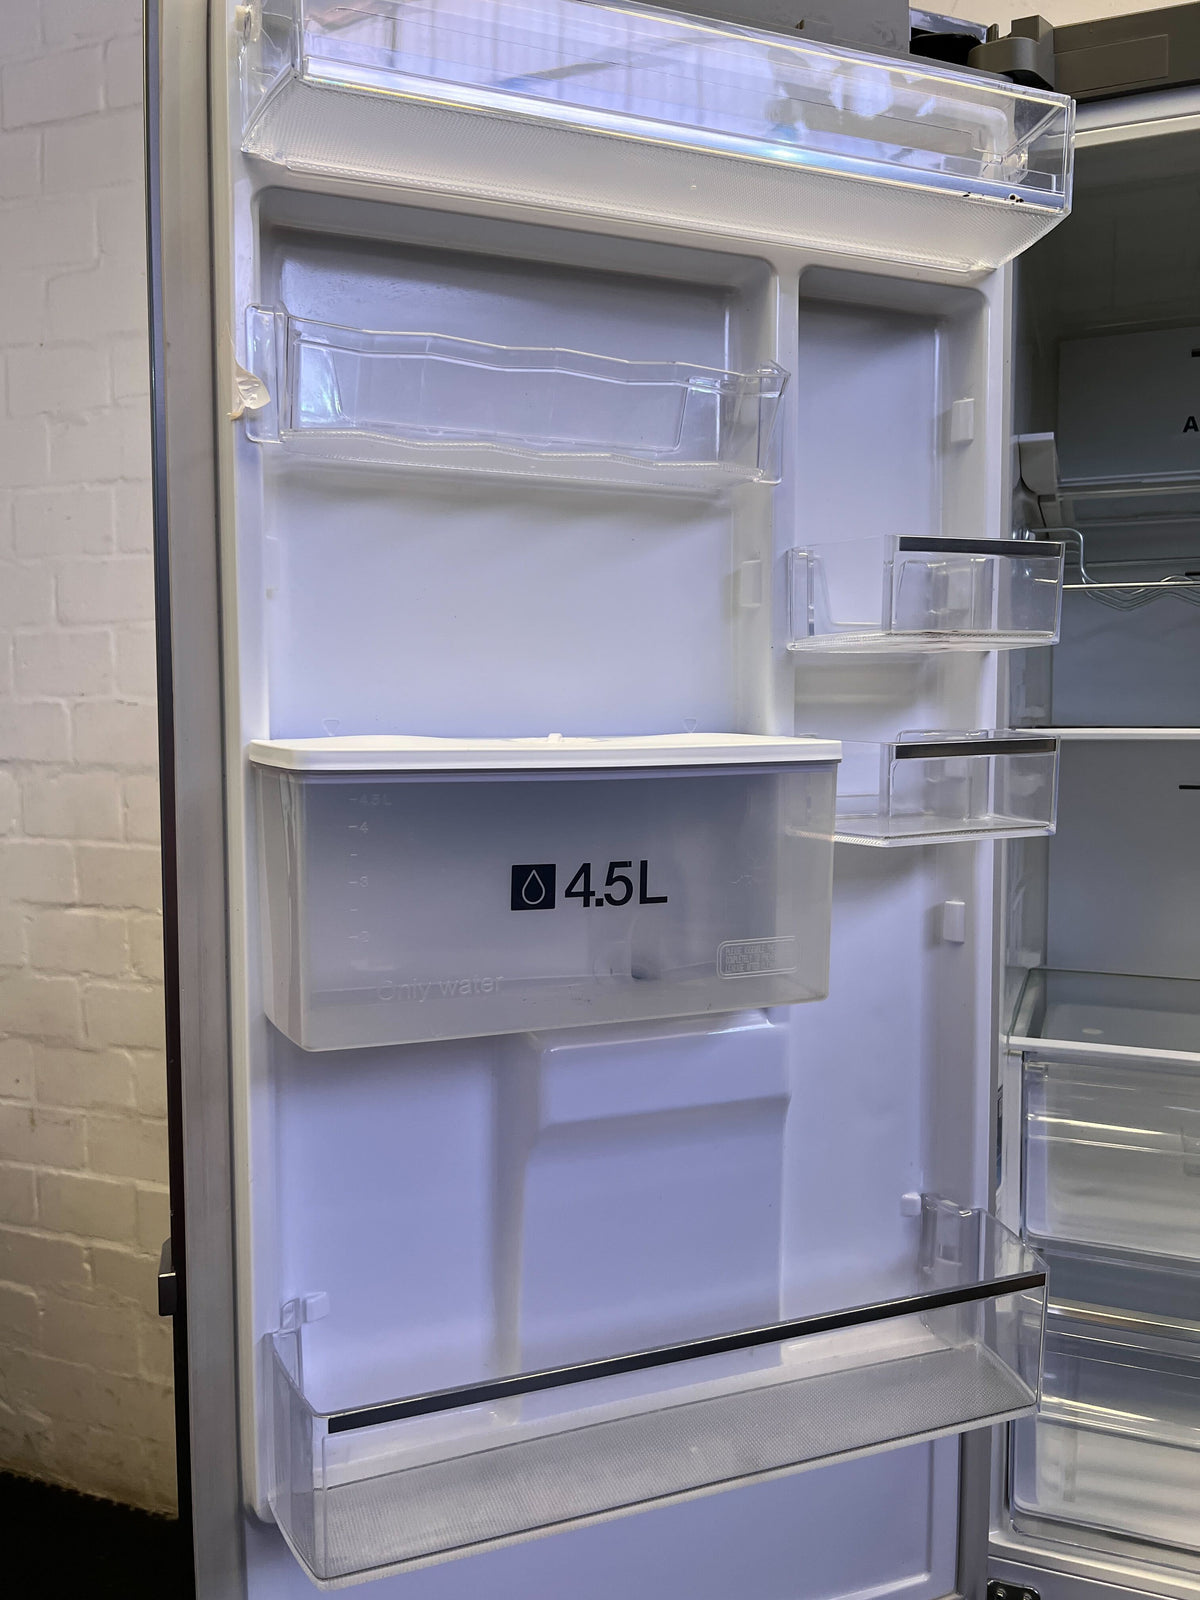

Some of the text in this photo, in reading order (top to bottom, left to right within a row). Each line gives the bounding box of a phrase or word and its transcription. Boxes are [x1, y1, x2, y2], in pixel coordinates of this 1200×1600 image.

[564, 859, 668, 908] 4.5L
[379, 975, 504, 1003] Only water
